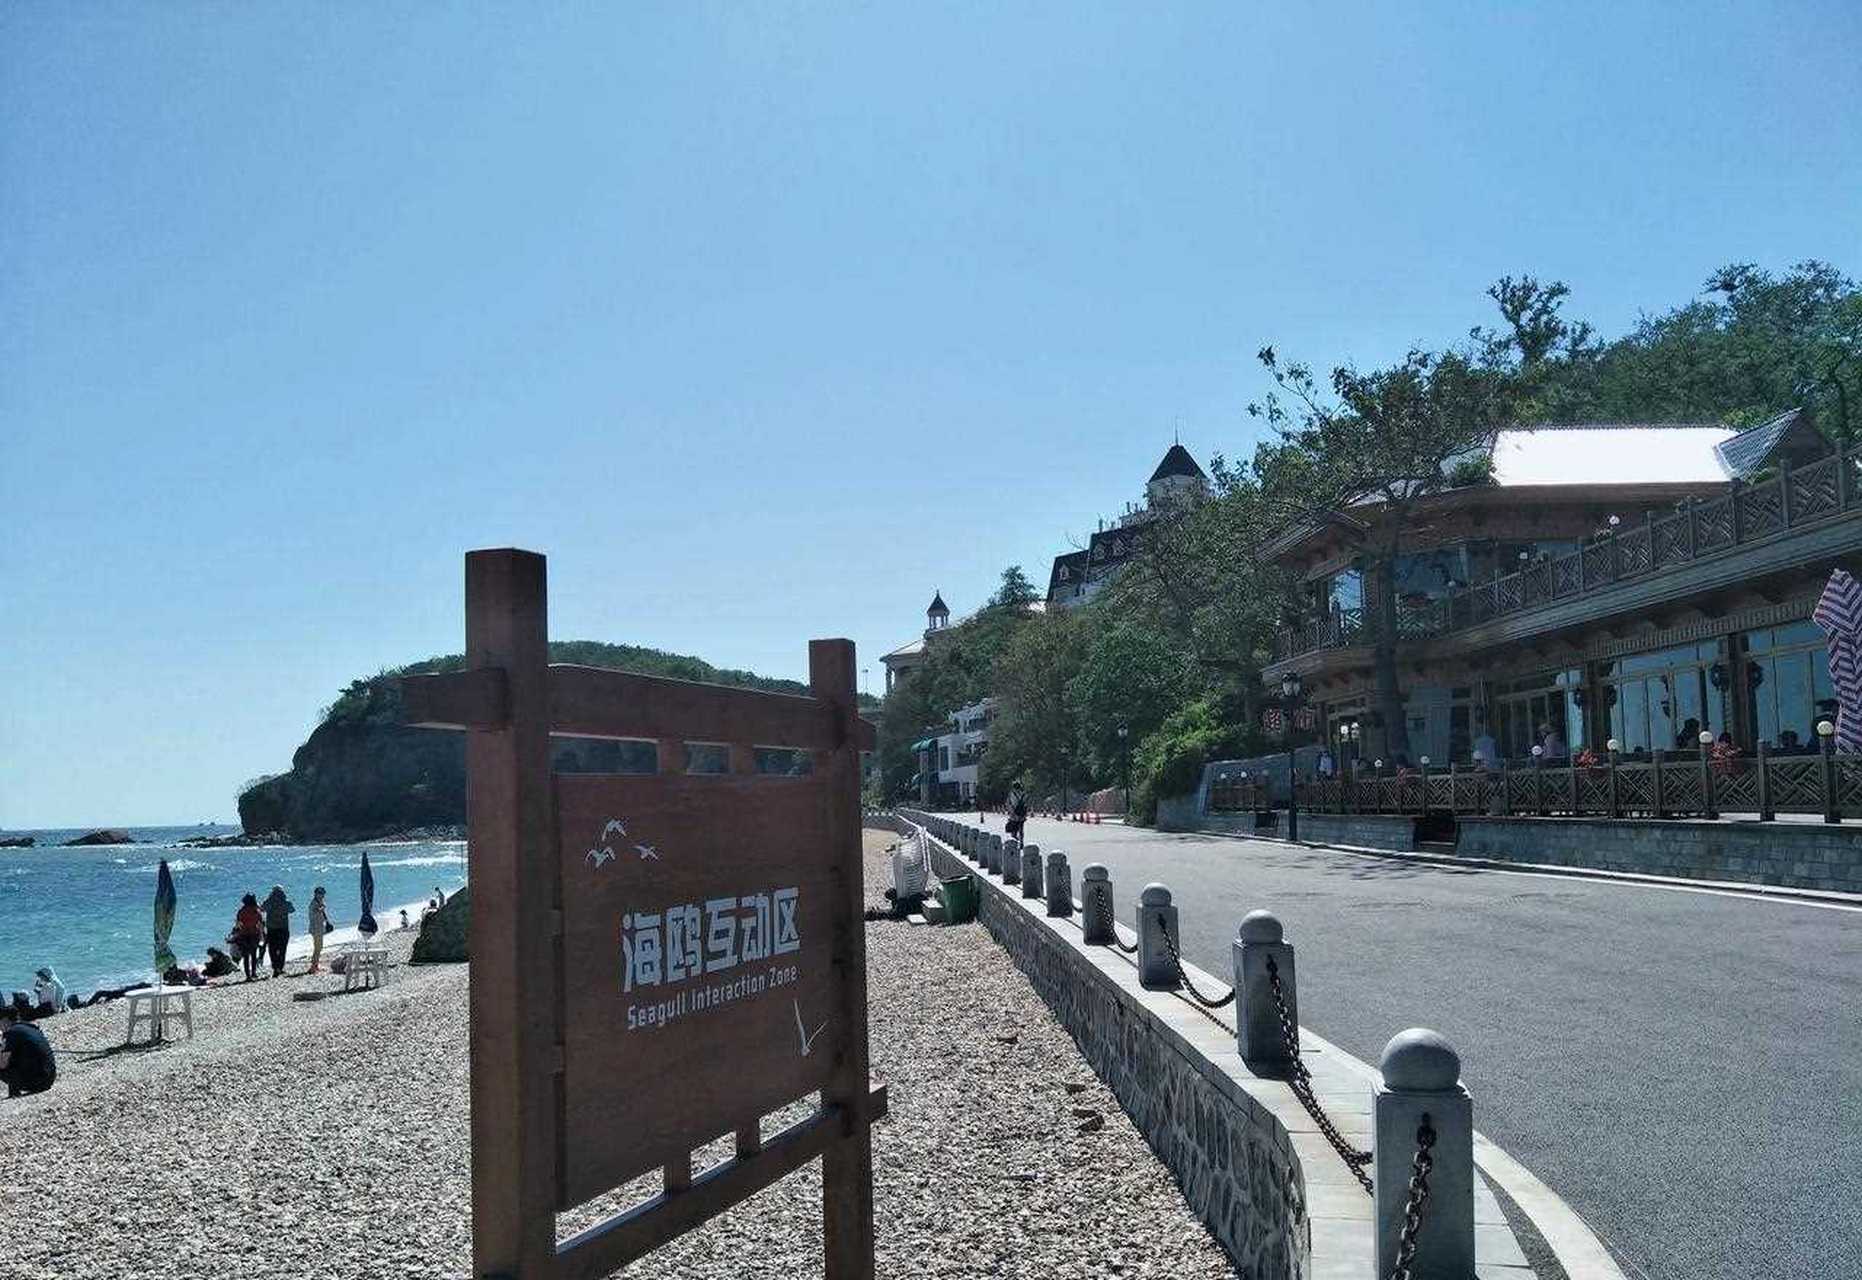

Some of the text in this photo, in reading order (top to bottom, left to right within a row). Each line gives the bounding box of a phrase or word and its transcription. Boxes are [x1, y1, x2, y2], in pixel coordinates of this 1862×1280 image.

[622, 887, 801, 993] 海鸥互动区
[627, 964, 798, 1030] Seagull Interaction Zone
